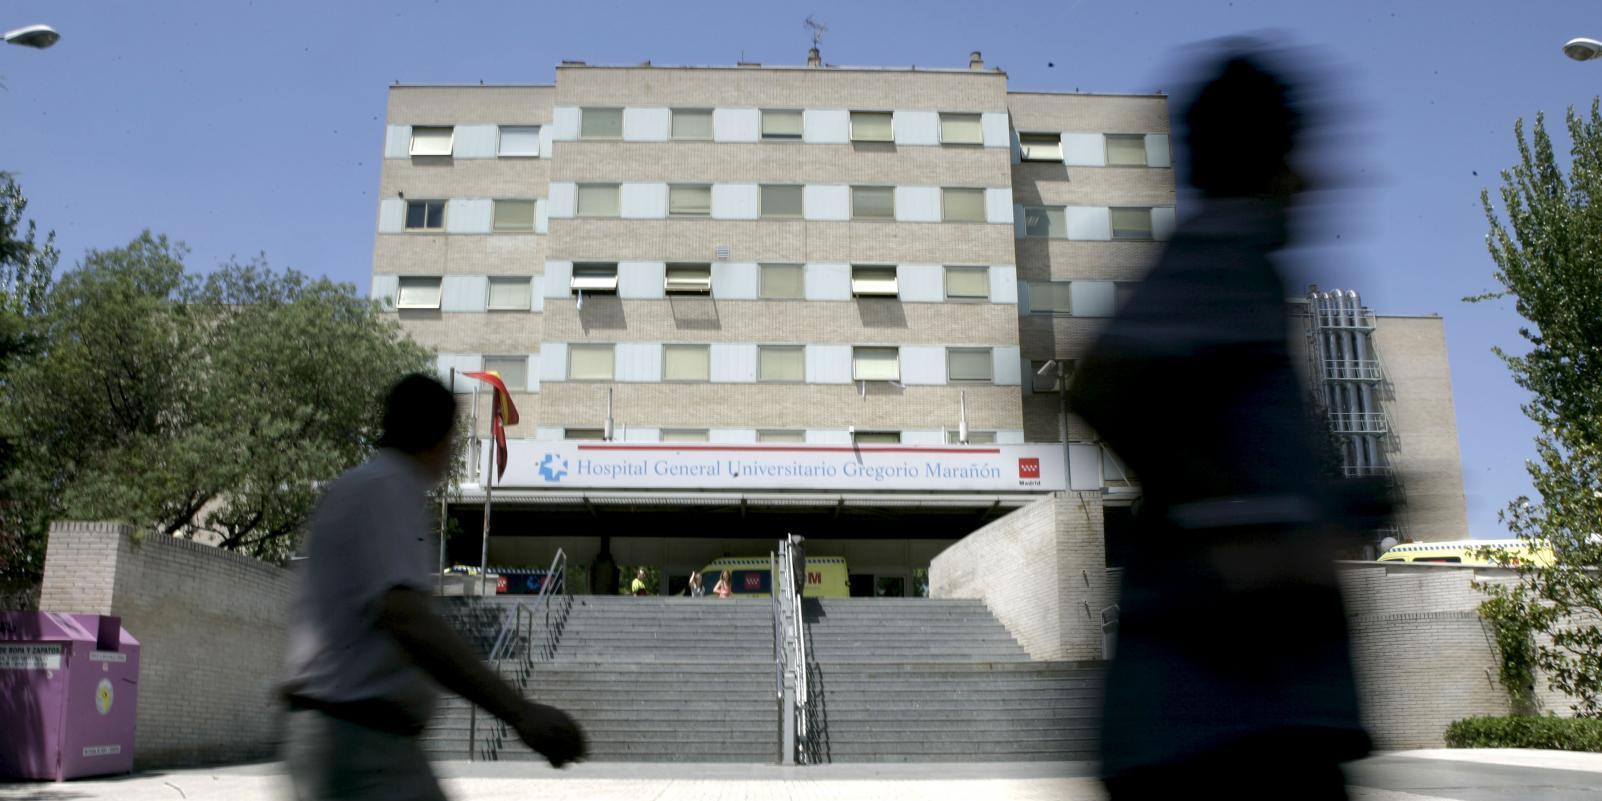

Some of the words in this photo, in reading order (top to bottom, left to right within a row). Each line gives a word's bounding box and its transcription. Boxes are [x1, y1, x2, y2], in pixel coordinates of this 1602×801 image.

[577, 459, 648, 479] Hospital
[654, 459, 720, 477] General
[728, 460, 837, 478] Universitario
[843, 461, 919, 481] Gregorio
[925, 462, 1001, 479] Marañón
[9, 647, 25, 655] ROPA
[27, 647, 32, 655] Y
[33, 647, 60, 655] ZAPATOS
